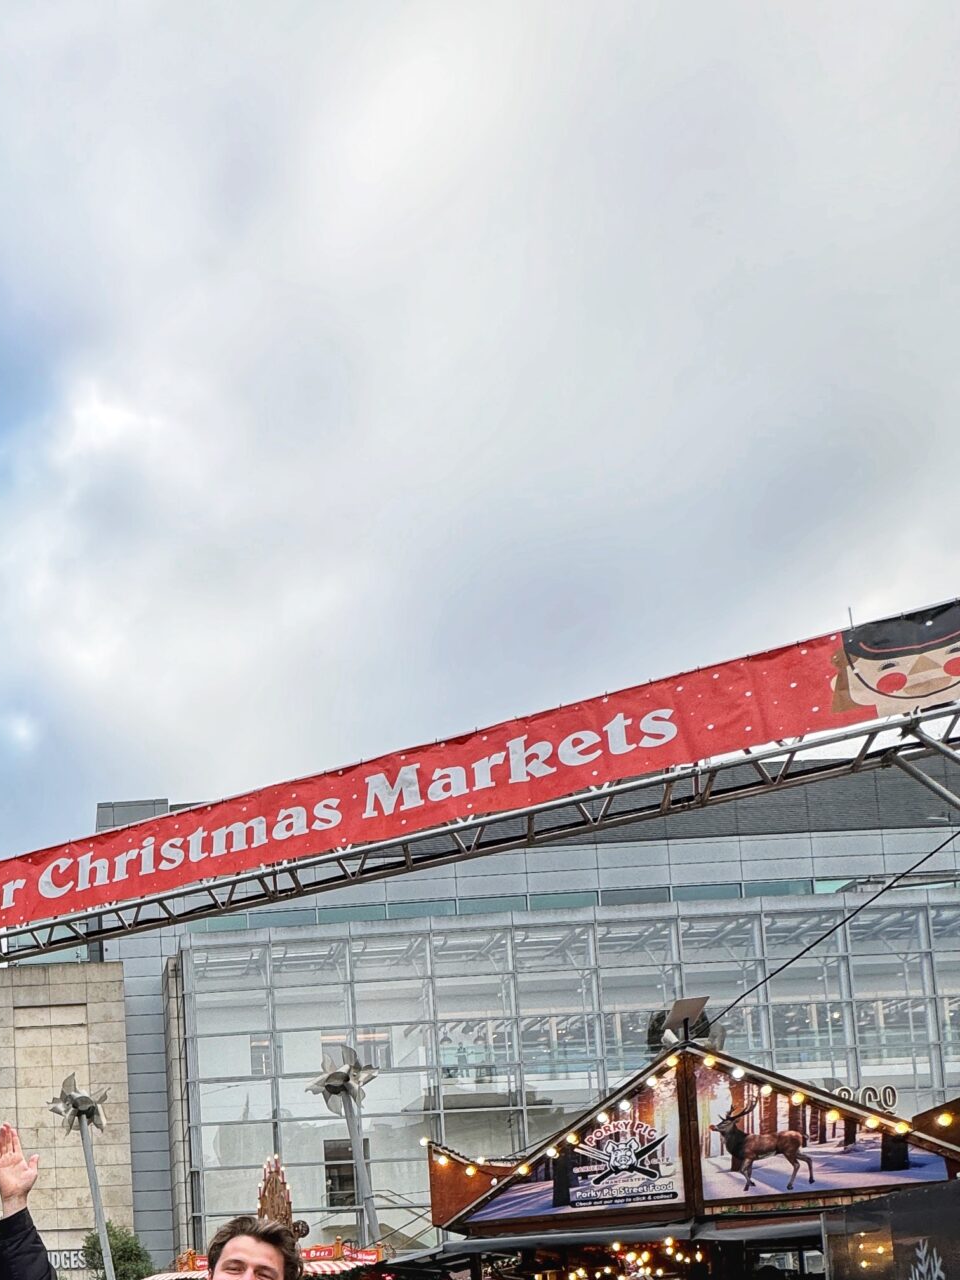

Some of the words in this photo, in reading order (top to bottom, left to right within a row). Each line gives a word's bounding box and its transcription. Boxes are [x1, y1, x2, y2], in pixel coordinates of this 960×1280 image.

[37, 797, 343, 900] Christmas
[361, 707, 678, 818] Markets
[584, 1119, 631, 1146] PORKY
[576, 1190, 601, 1199] Porky
[603, 1188, 619, 1197] Pig
[620, 1184, 648, 1194] Street
[649, 1180, 674, 1191] Food
